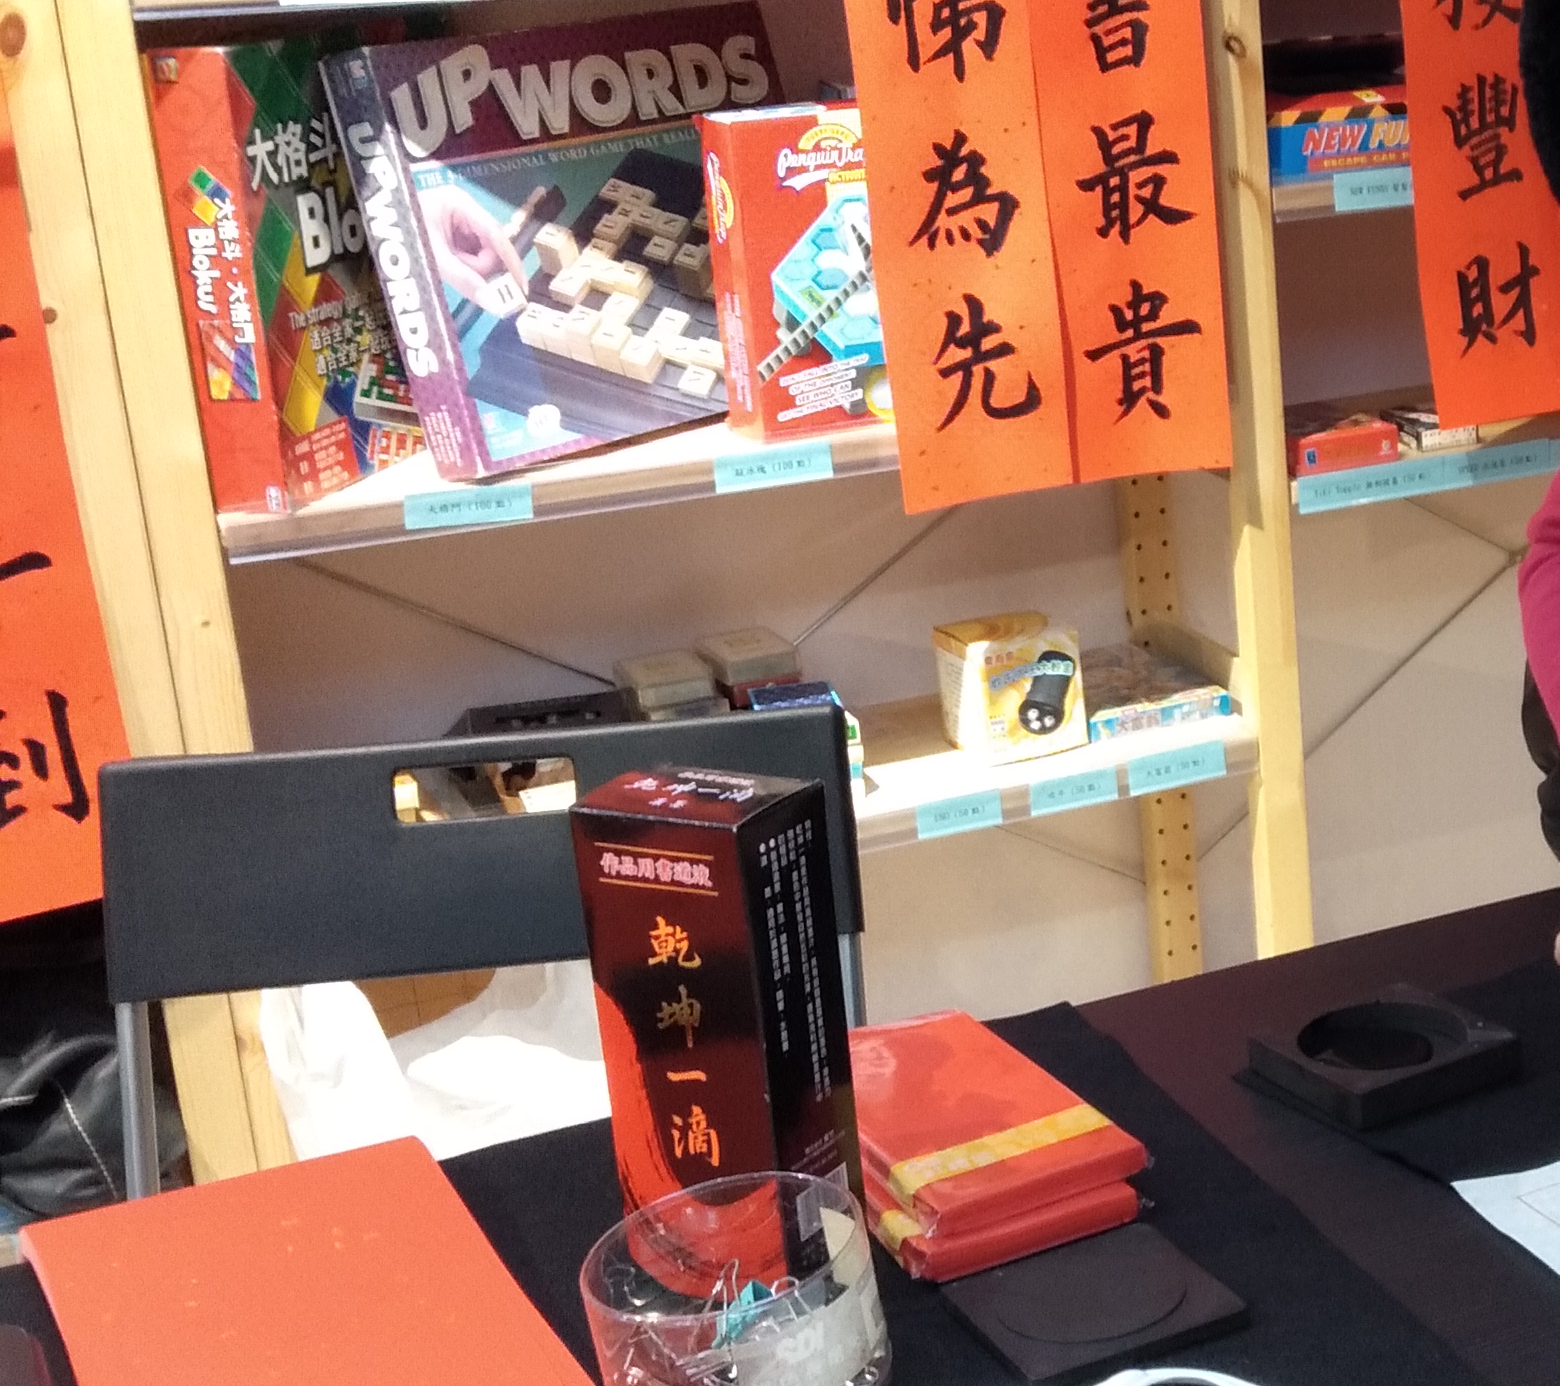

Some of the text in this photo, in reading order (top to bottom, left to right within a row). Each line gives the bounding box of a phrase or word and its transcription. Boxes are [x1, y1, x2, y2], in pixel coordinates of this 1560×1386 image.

[389, 34, 770, 159] UPWORDS
[1302, 122, 1368, 156] NEW
[549, 146, 588, 164] WORD
[589, 141, 627, 157] GAME
[626, 135, 661, 151] THAT
[836, 142, 865, 167] Tra
[187, 225, 220, 315] Blokus
[295, 185, 366, 270] Blo
[347, 121, 439, 379] UPWORDS
[647, 915, 721, 1169] 乾坤一滴
